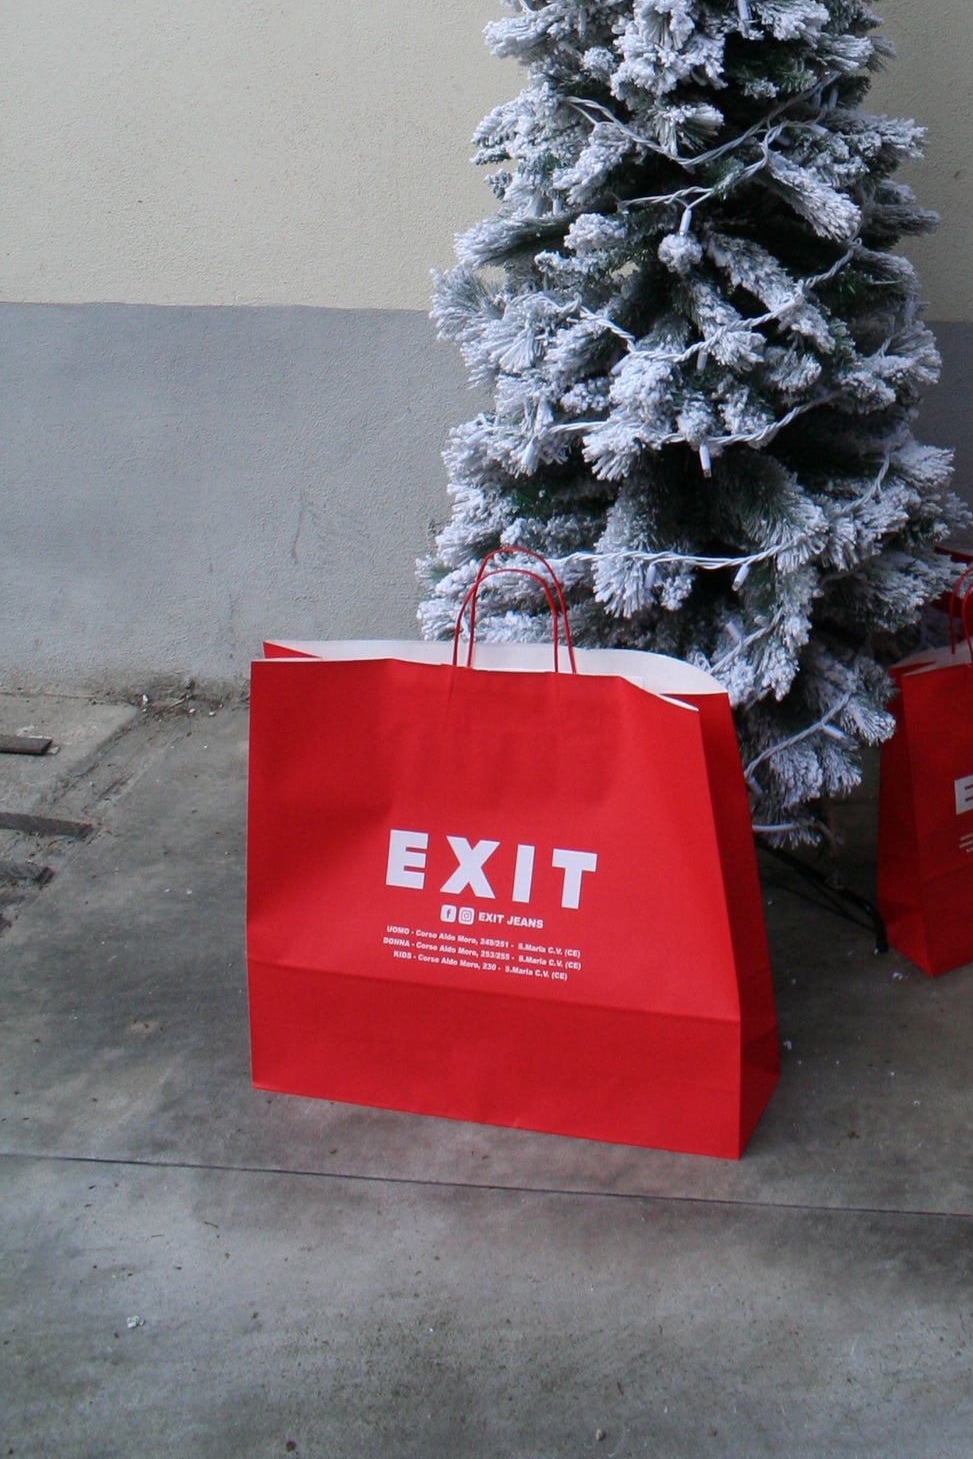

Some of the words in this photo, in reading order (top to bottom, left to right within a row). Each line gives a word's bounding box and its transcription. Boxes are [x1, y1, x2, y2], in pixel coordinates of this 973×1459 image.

[385, 829, 598, 910] EXIT
[478, 911, 504, 924] EXIT
[506, 916, 544, 929] JEANS
[383, 936, 410, 947] DONNA
[416, 941, 438, 951] Corso
[439, 945, 456, 953] Aldo
[457, 947, 479, 957] Moro,
[548, 959, 563, 968] C.V.
[565, 961, 581, 970] (CE)
[386, 925, 410, 935] UOMO
[415, 929, 437, 939] Corso
[439, 933, 456, 941] Aldo
[457, 935, 478, 946] Moro,
[548, 947, 563, 955] C.V.
[564, 949, 581, 958] (CE)
[393, 950, 412, 959] KIDS
[418, 954, 440, 963] Corso
[441, 957, 458, 966] Aldo
[459, 959, 481, 970] Moro,
[482, 962, 496, 971] 230
[535, 969, 550, 978] C.V.
[551, 971, 568, 981] (CE)
